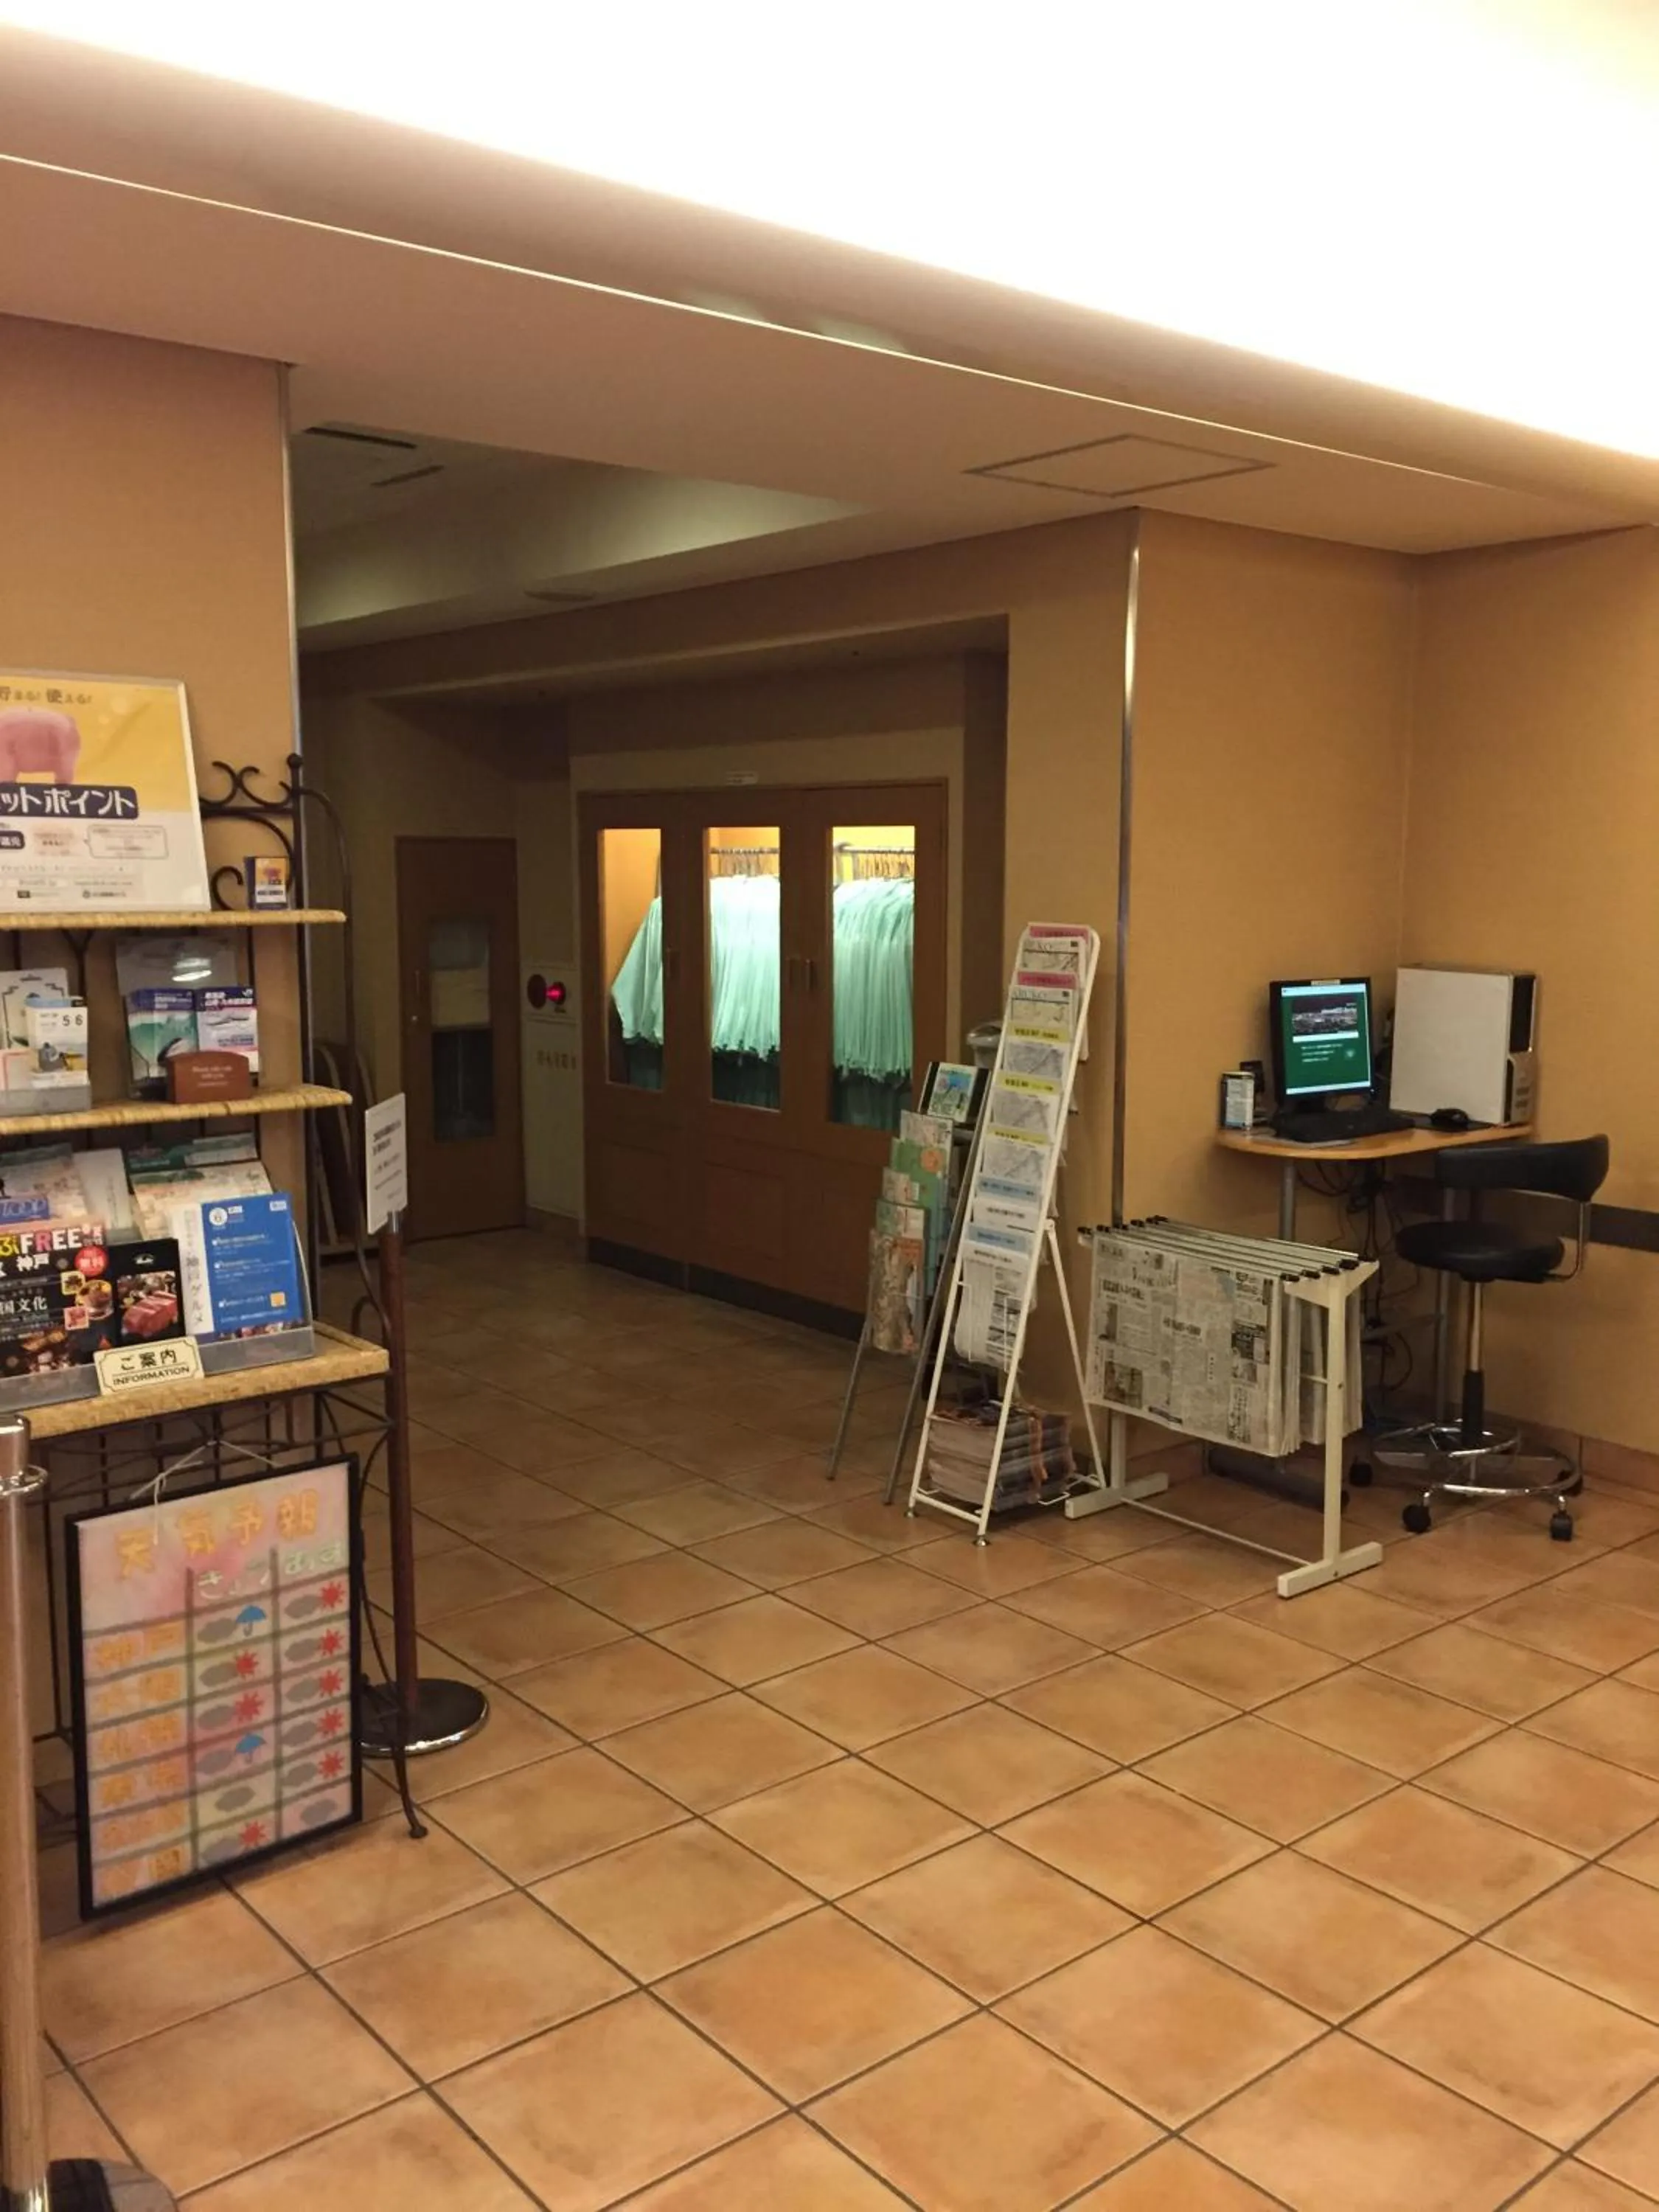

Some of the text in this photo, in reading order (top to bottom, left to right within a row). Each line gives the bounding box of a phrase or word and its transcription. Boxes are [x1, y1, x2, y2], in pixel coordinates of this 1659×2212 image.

[120, 1349, 177, 1371] ご案内
[114, 1366, 189, 1385] INFORMATION
